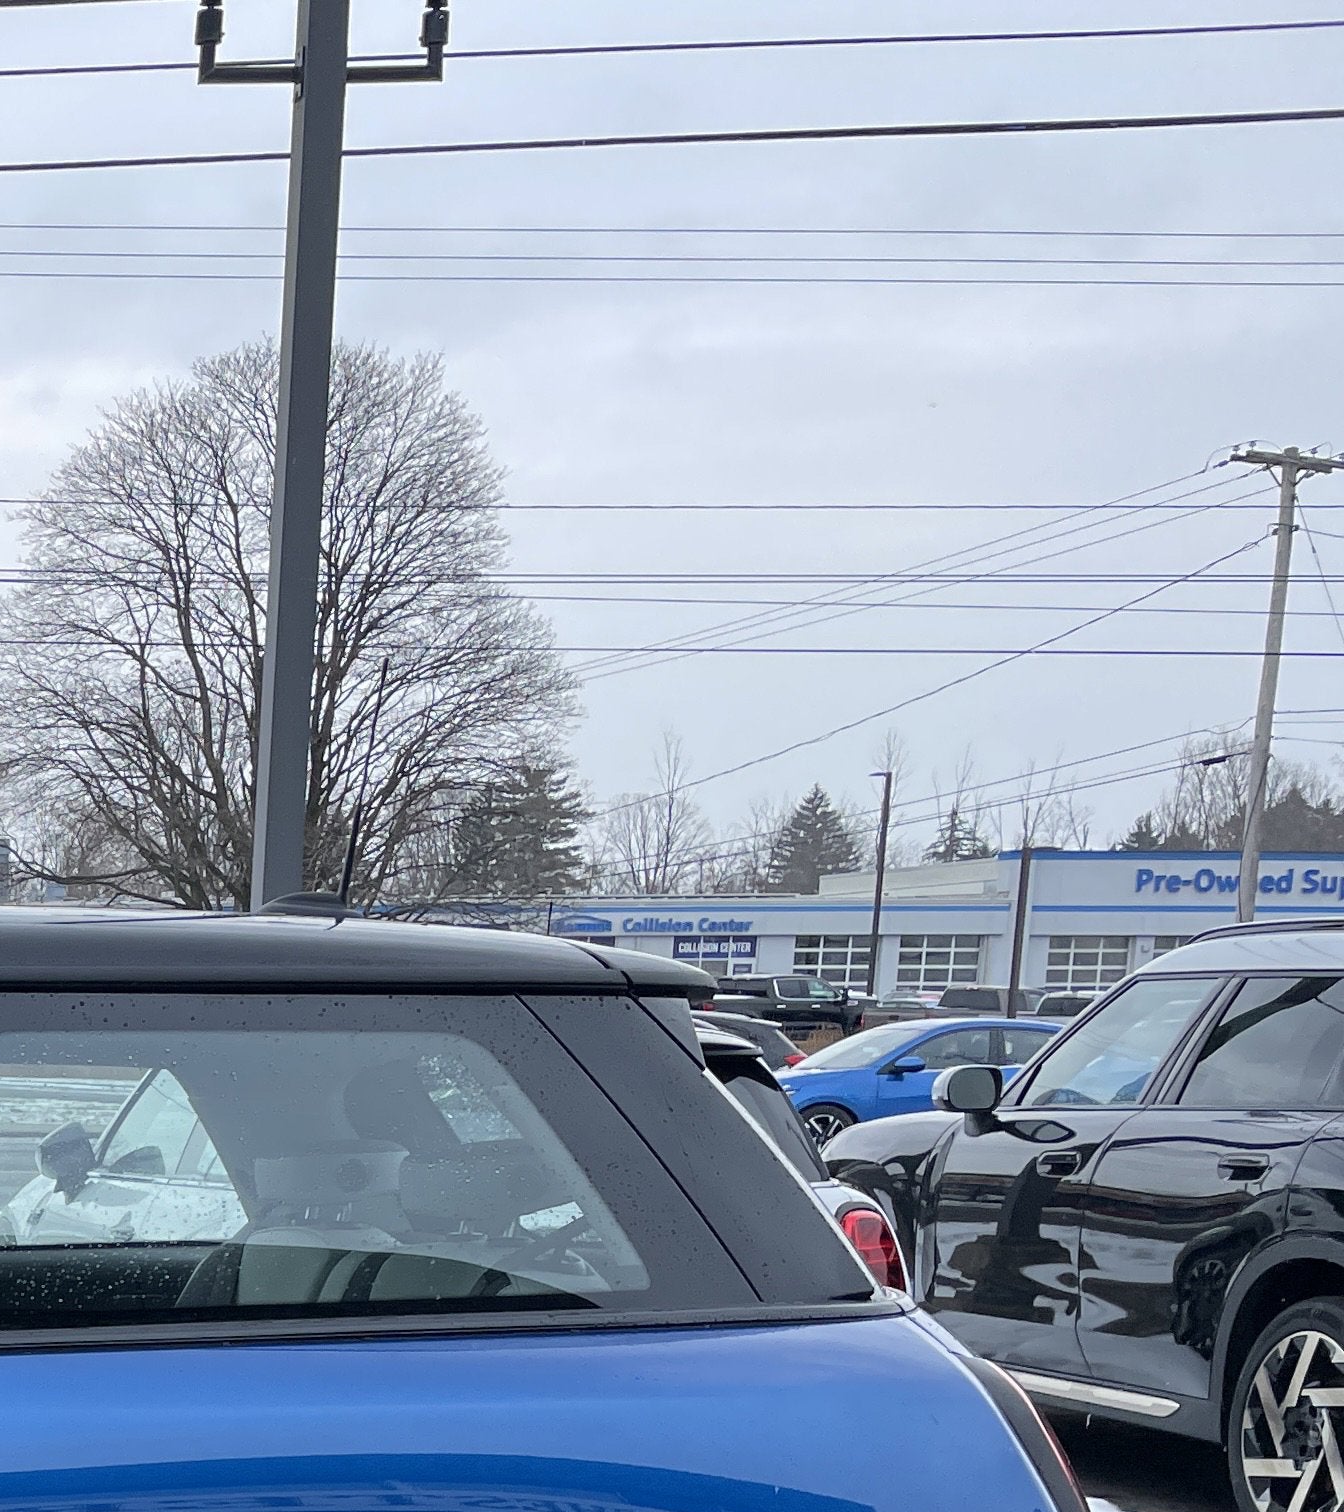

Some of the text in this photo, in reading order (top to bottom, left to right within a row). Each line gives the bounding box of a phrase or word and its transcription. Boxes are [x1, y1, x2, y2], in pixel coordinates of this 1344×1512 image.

[1135, 868, 1344, 901] Pre-Owed Su
[622, 917, 694, 933] Collision
[698, 917, 754, 933] Center
